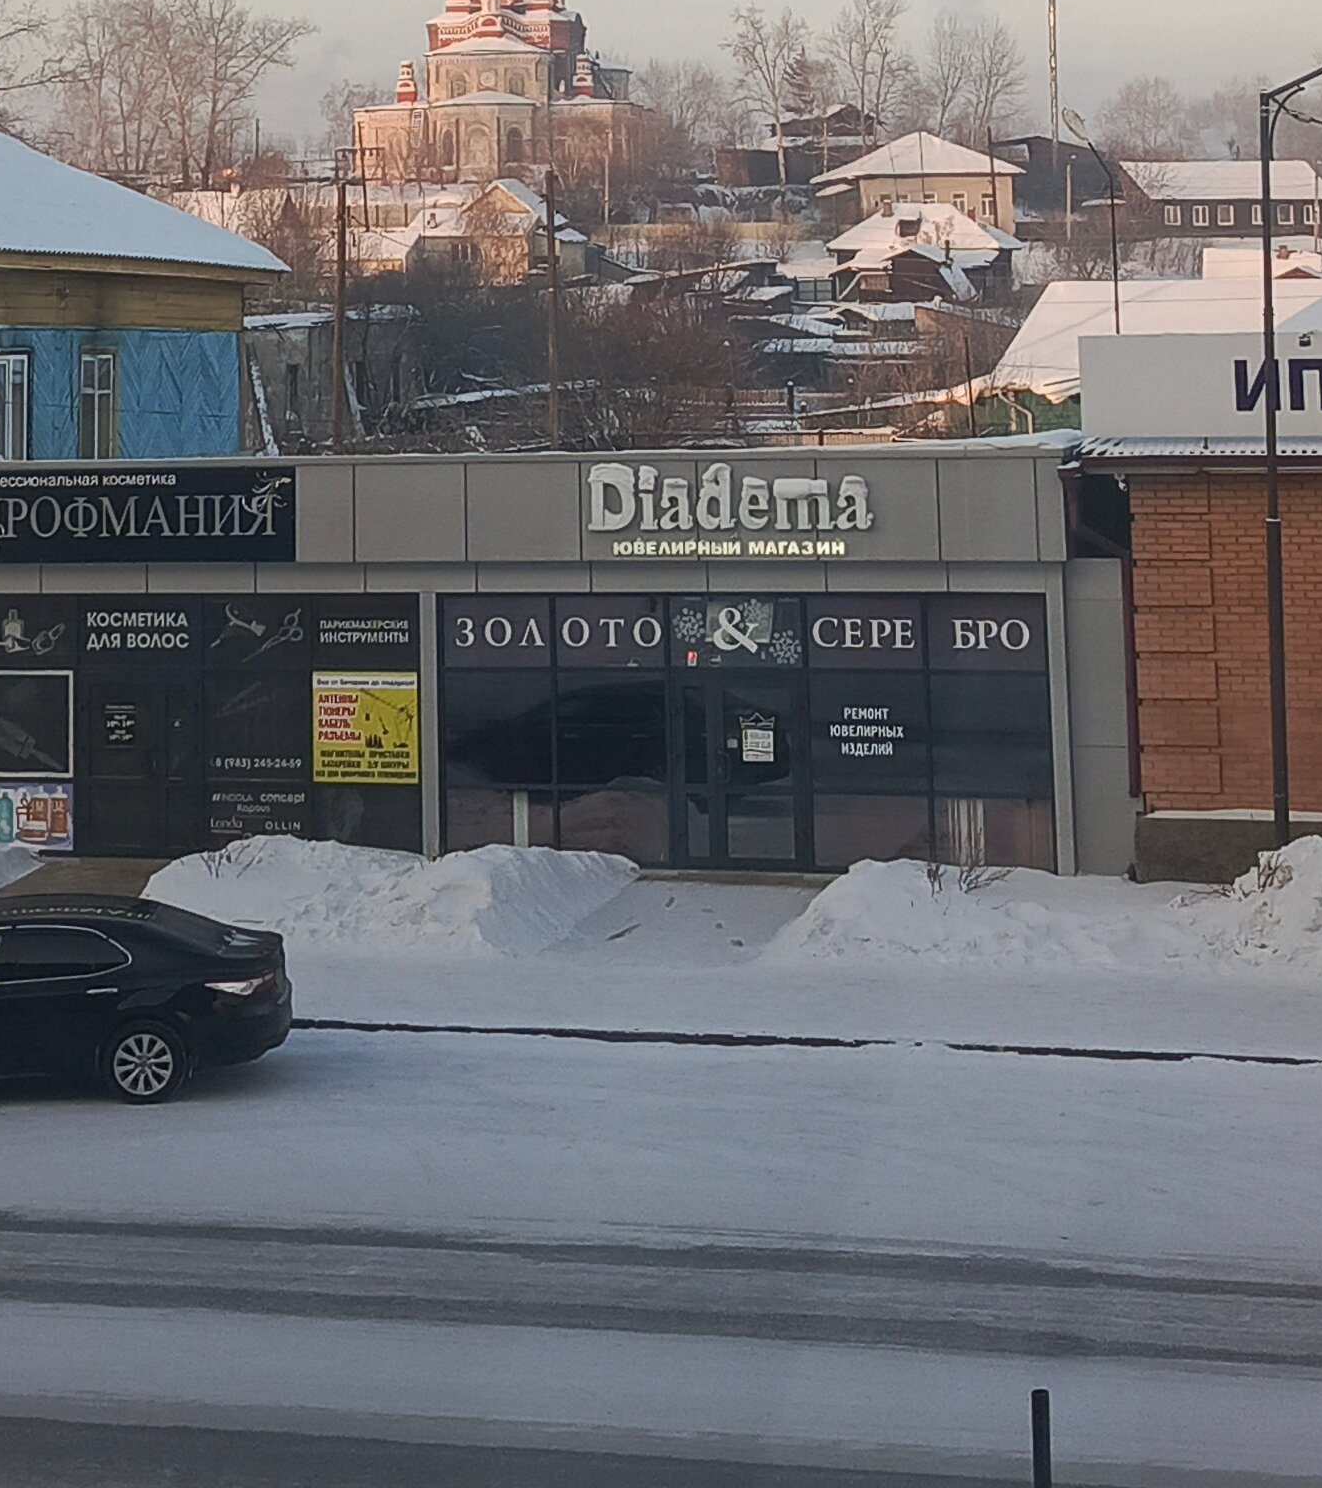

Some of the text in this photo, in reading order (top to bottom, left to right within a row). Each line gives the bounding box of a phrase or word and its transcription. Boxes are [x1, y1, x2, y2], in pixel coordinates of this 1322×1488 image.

[102, 472, 177, 487] косметика
[587, 462, 875, 531] Diadema
[613, 538, 846, 556] ЮВЕЛИРНЫЙ МАГАЗИН
[86, 612, 188, 627] КОСМЕТИКА
[86, 633, 190, 651] ДЛЯ ВОЛОС
[320, 631, 409, 644] ИНСТРУМЕНТЫ
[843, 707, 890, 720] РЕМОНТ
[830, 724, 905, 739] ЮВЕЛИРНЫХ
[841, 741, 894, 757] ИЗДЕЛИЙ
[264, 821, 301, 830] OLLIN
